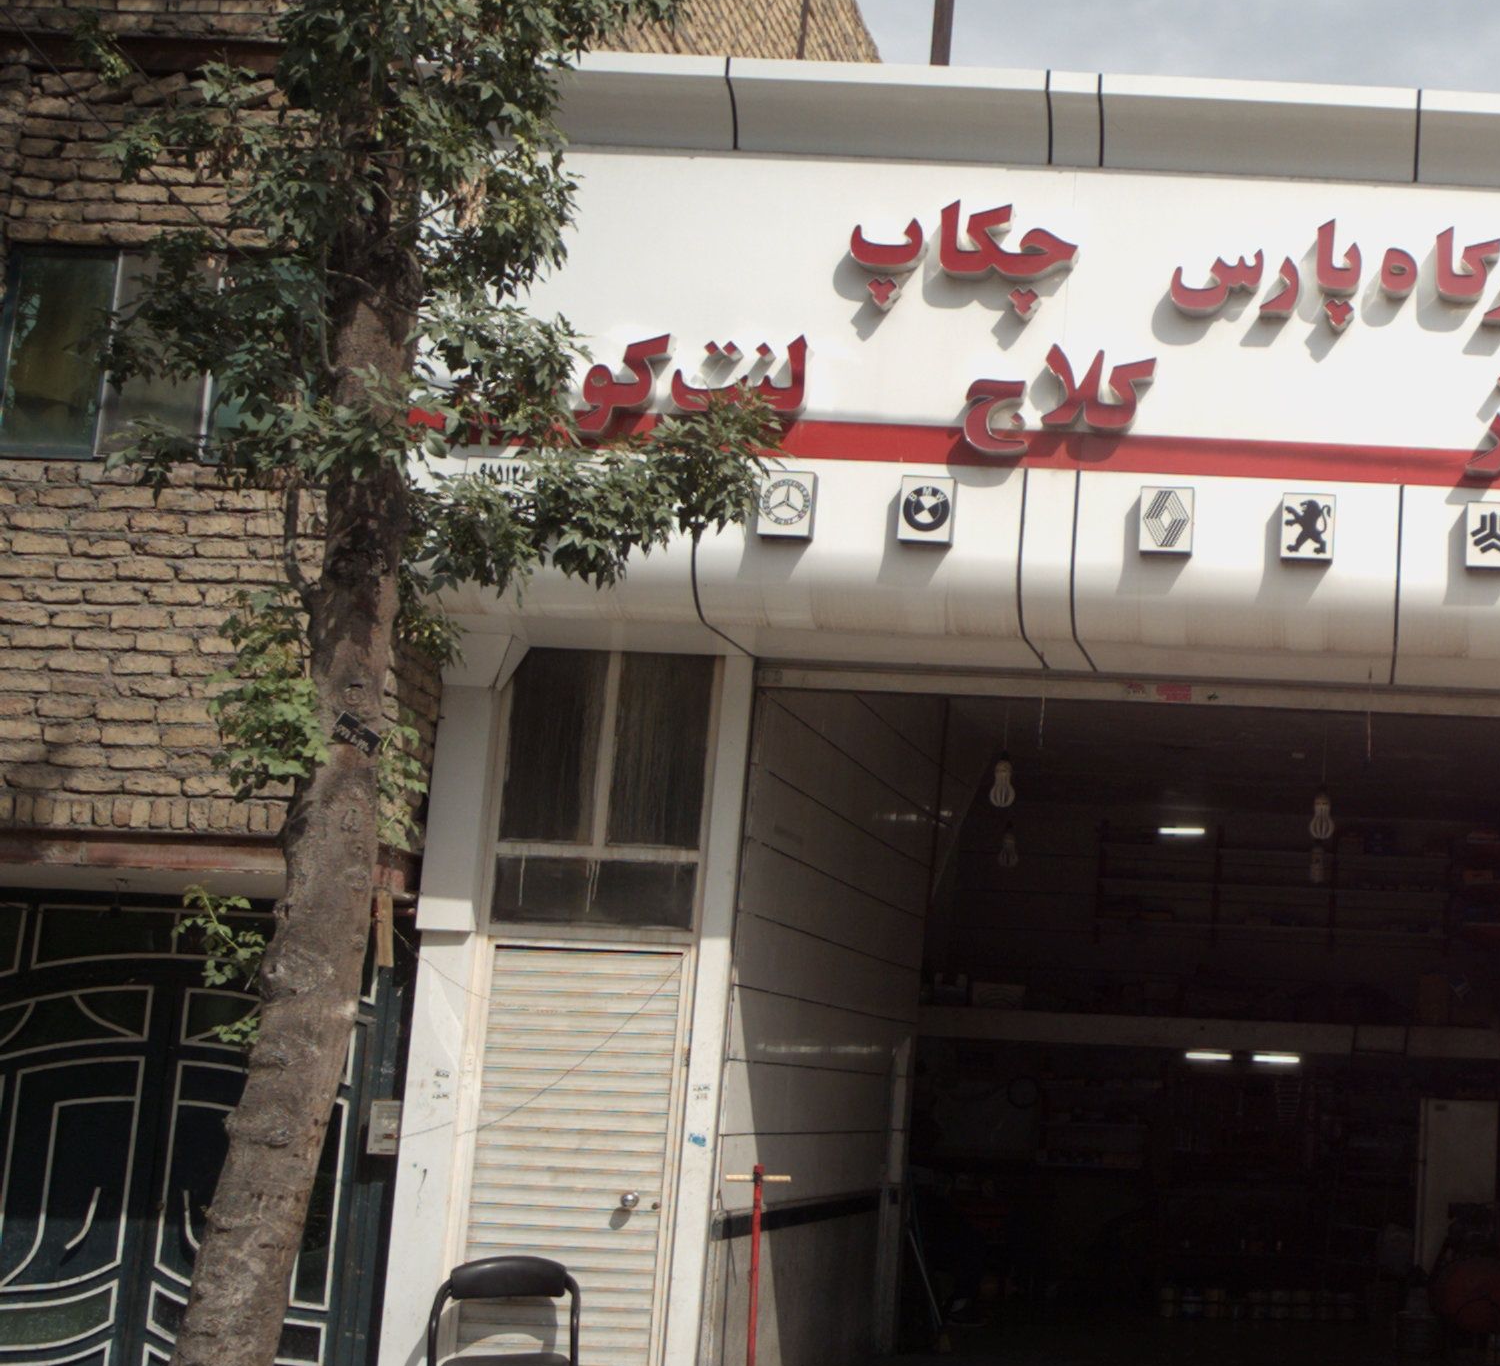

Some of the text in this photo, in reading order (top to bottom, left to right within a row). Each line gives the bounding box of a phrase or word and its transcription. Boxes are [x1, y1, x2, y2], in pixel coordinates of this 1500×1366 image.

[849, 199, 1079, 320] چکاپ
[1170, 219, 1362, 329] پارس
[907, 485, 948, 503] BMW
